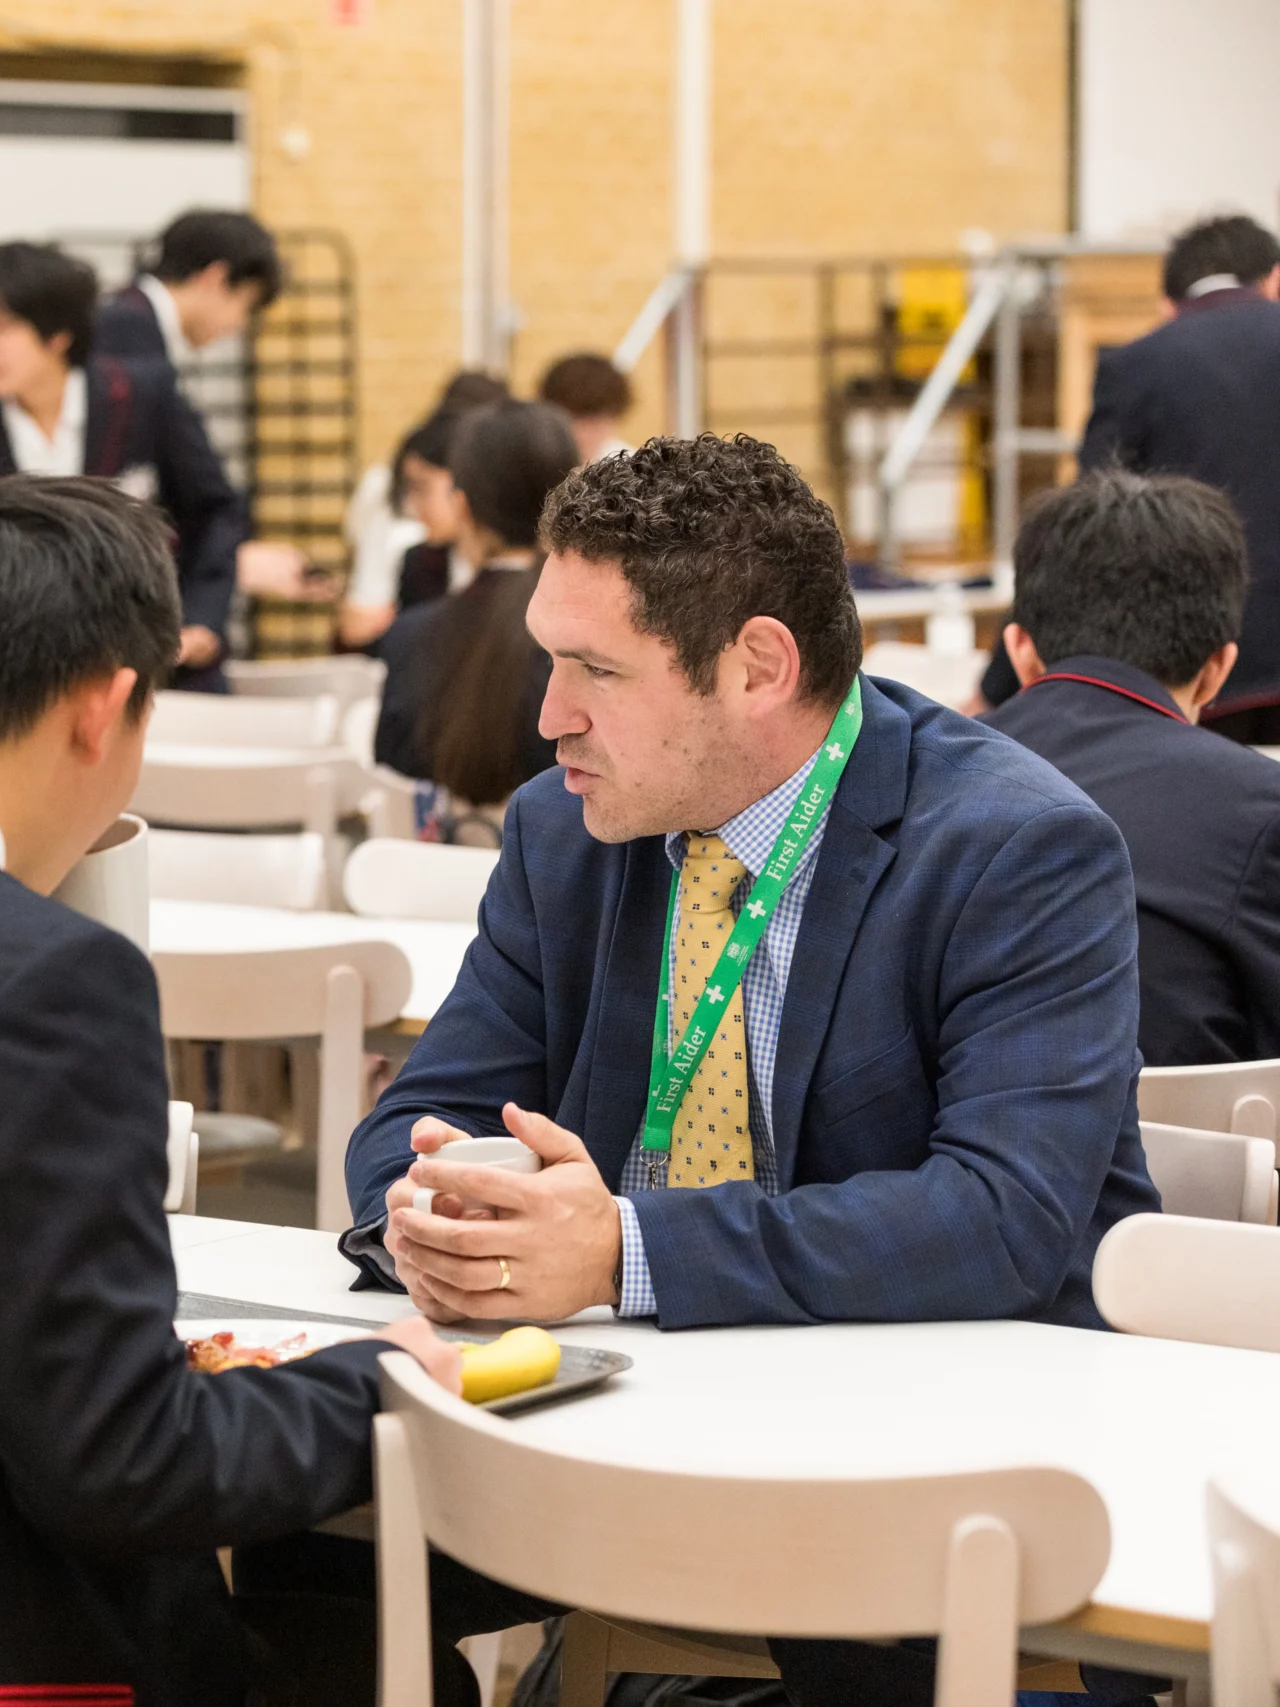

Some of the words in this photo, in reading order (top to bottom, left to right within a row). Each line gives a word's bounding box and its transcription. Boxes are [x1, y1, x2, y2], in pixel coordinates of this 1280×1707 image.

[765, 838, 798, 882] First
[789, 783, 826, 838] Aider
[656, 1076, 684, 1113] First
[677, 1025, 707, 1075] Aider
